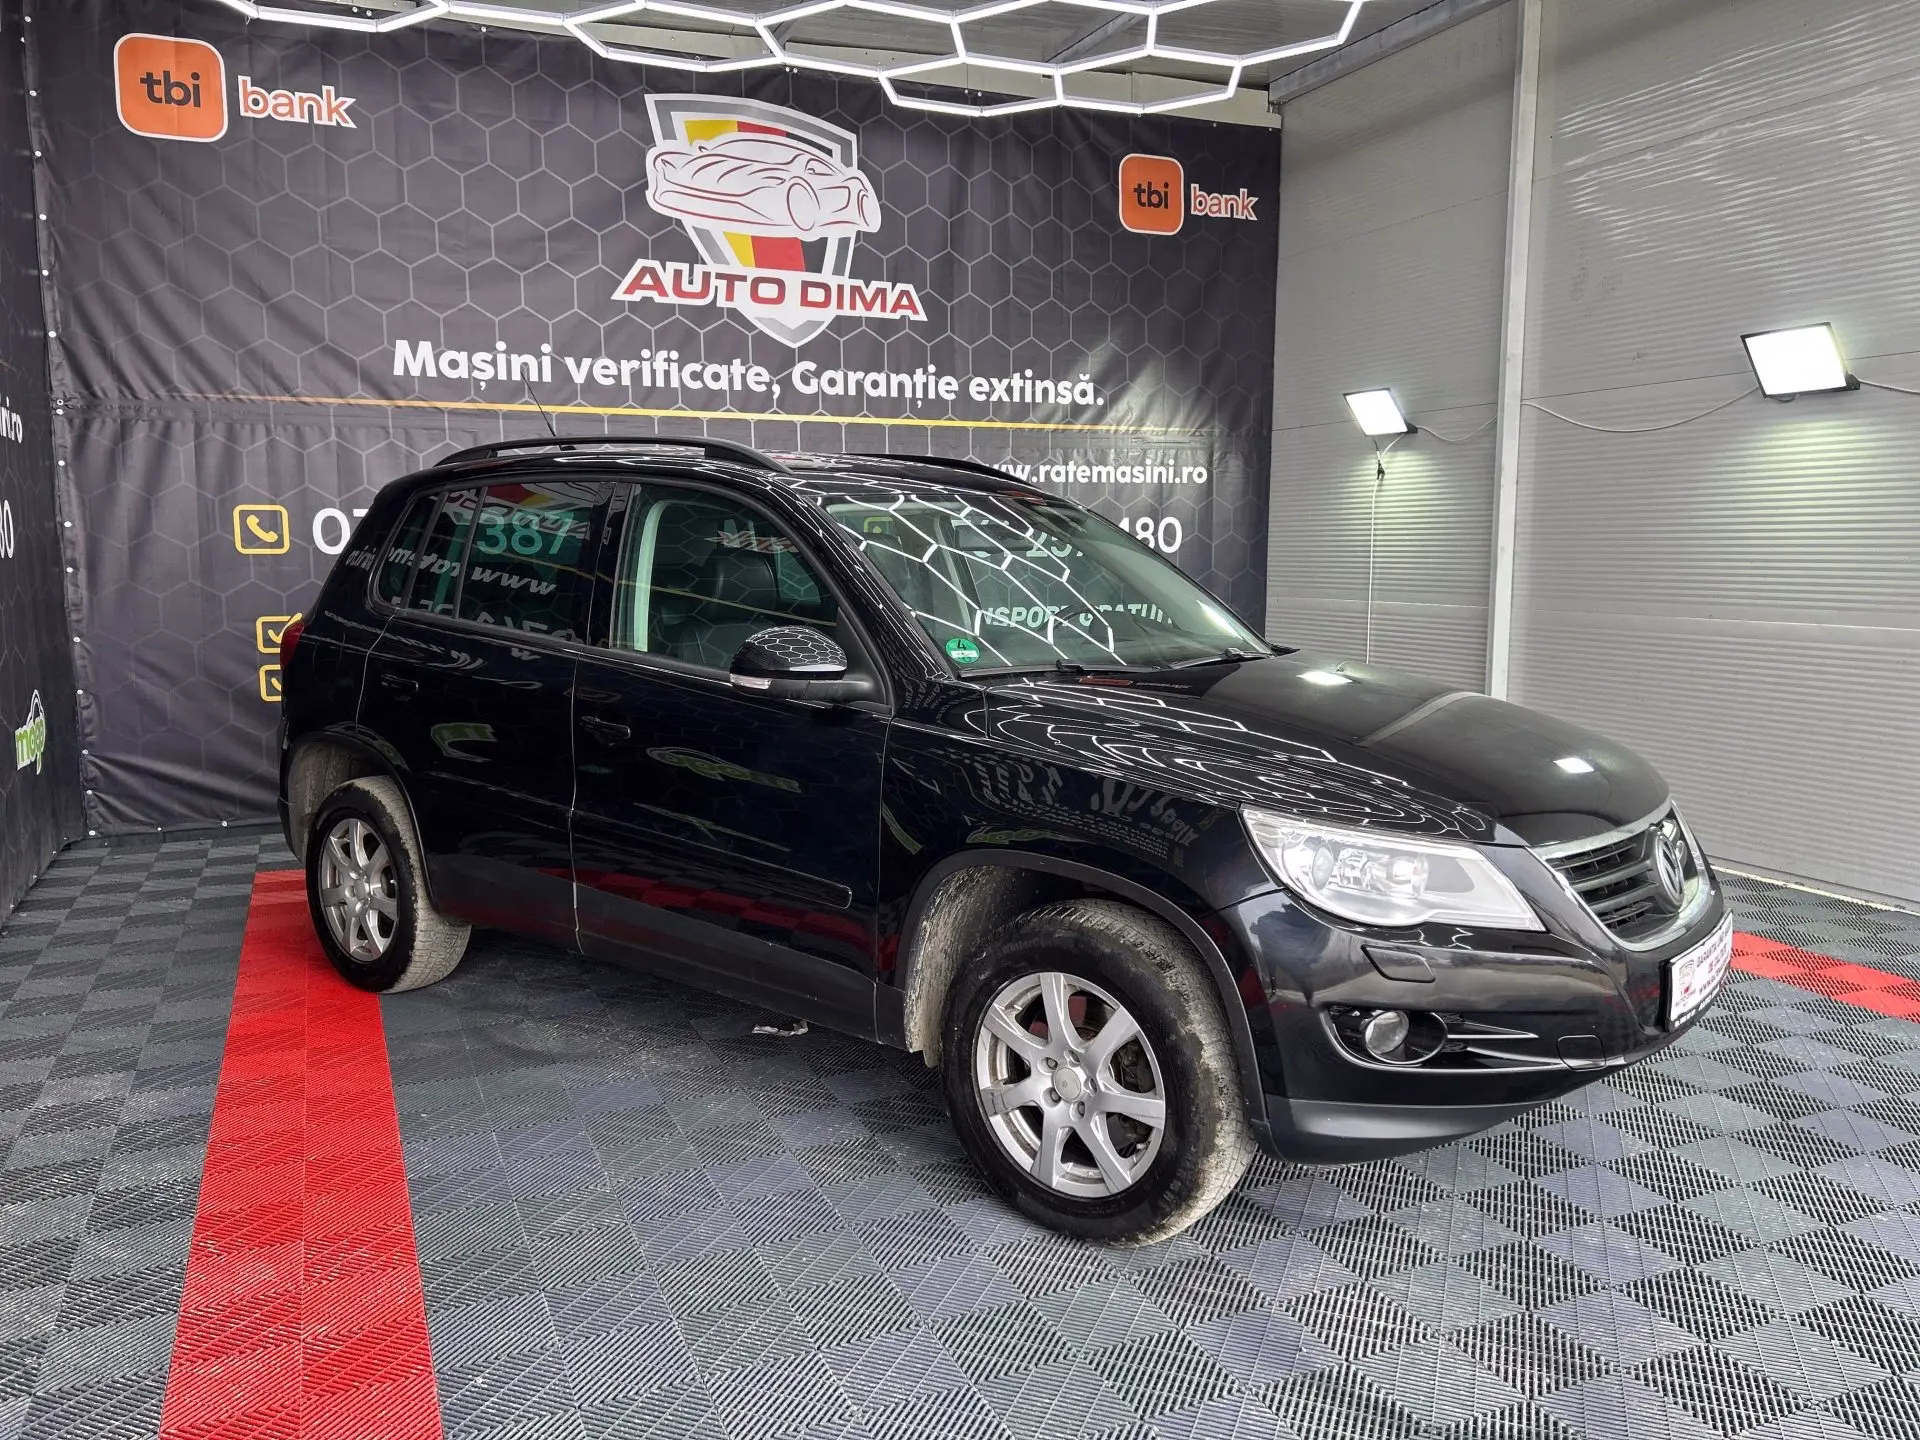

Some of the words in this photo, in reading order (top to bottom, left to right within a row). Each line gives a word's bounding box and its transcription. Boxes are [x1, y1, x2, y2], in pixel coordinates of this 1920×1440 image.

[139, 70, 202, 108] tbi
[238, 75, 357, 129] bank
[1133, 181, 1170, 210] tbi
[1190, 183, 1260, 221] bank
[619, 264, 788, 306] AUTO
[799, 279, 922, 317] DIMA
[393, 339, 552, 391] Mașini
[564, 348, 782, 400] verificate,
[793, 359, 958, 408] Garanție
[974, 368, 1105, 406] extinsă.
[984, 458, 1209, 485] w.ratemasini.ro
